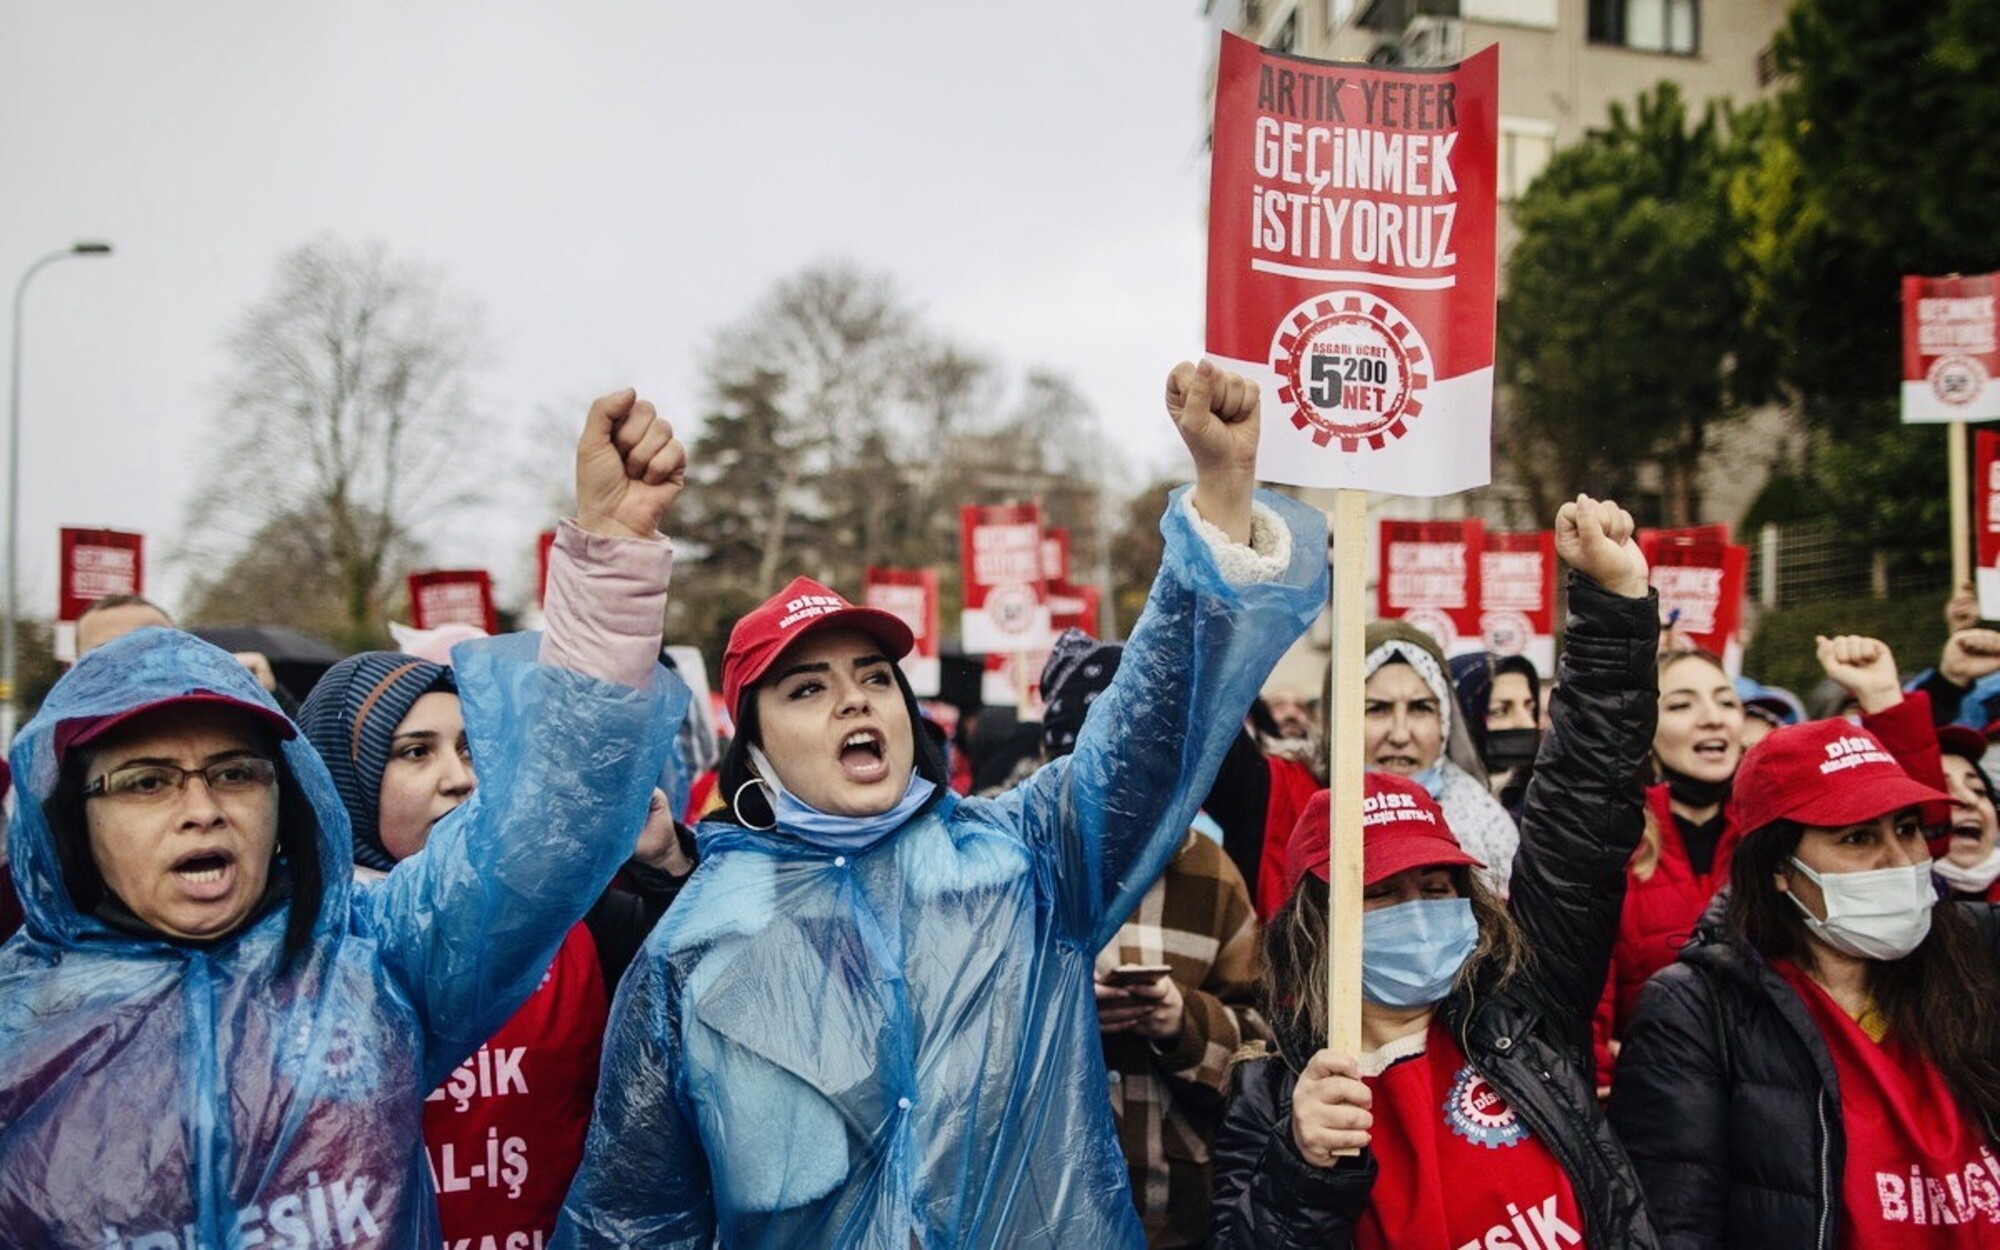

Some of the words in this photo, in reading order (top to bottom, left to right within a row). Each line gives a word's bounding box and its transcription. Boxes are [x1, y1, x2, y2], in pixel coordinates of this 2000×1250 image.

[1258, 64, 1346, 123] ARTIK
[1360, 79, 1458, 130] YETER
[1254, 116, 1459, 196] GEÇİNMEK
[1252, 185, 1457, 269] İSTİYORUZ
[1342, 385, 1386, 412] NET
[785, 594, 842, 614] DİSK
[1824, 736, 1878, 759] DİSK
[1363, 791, 1417, 813] DİSK
[425, 1042, 530, 1113] ŞİK
